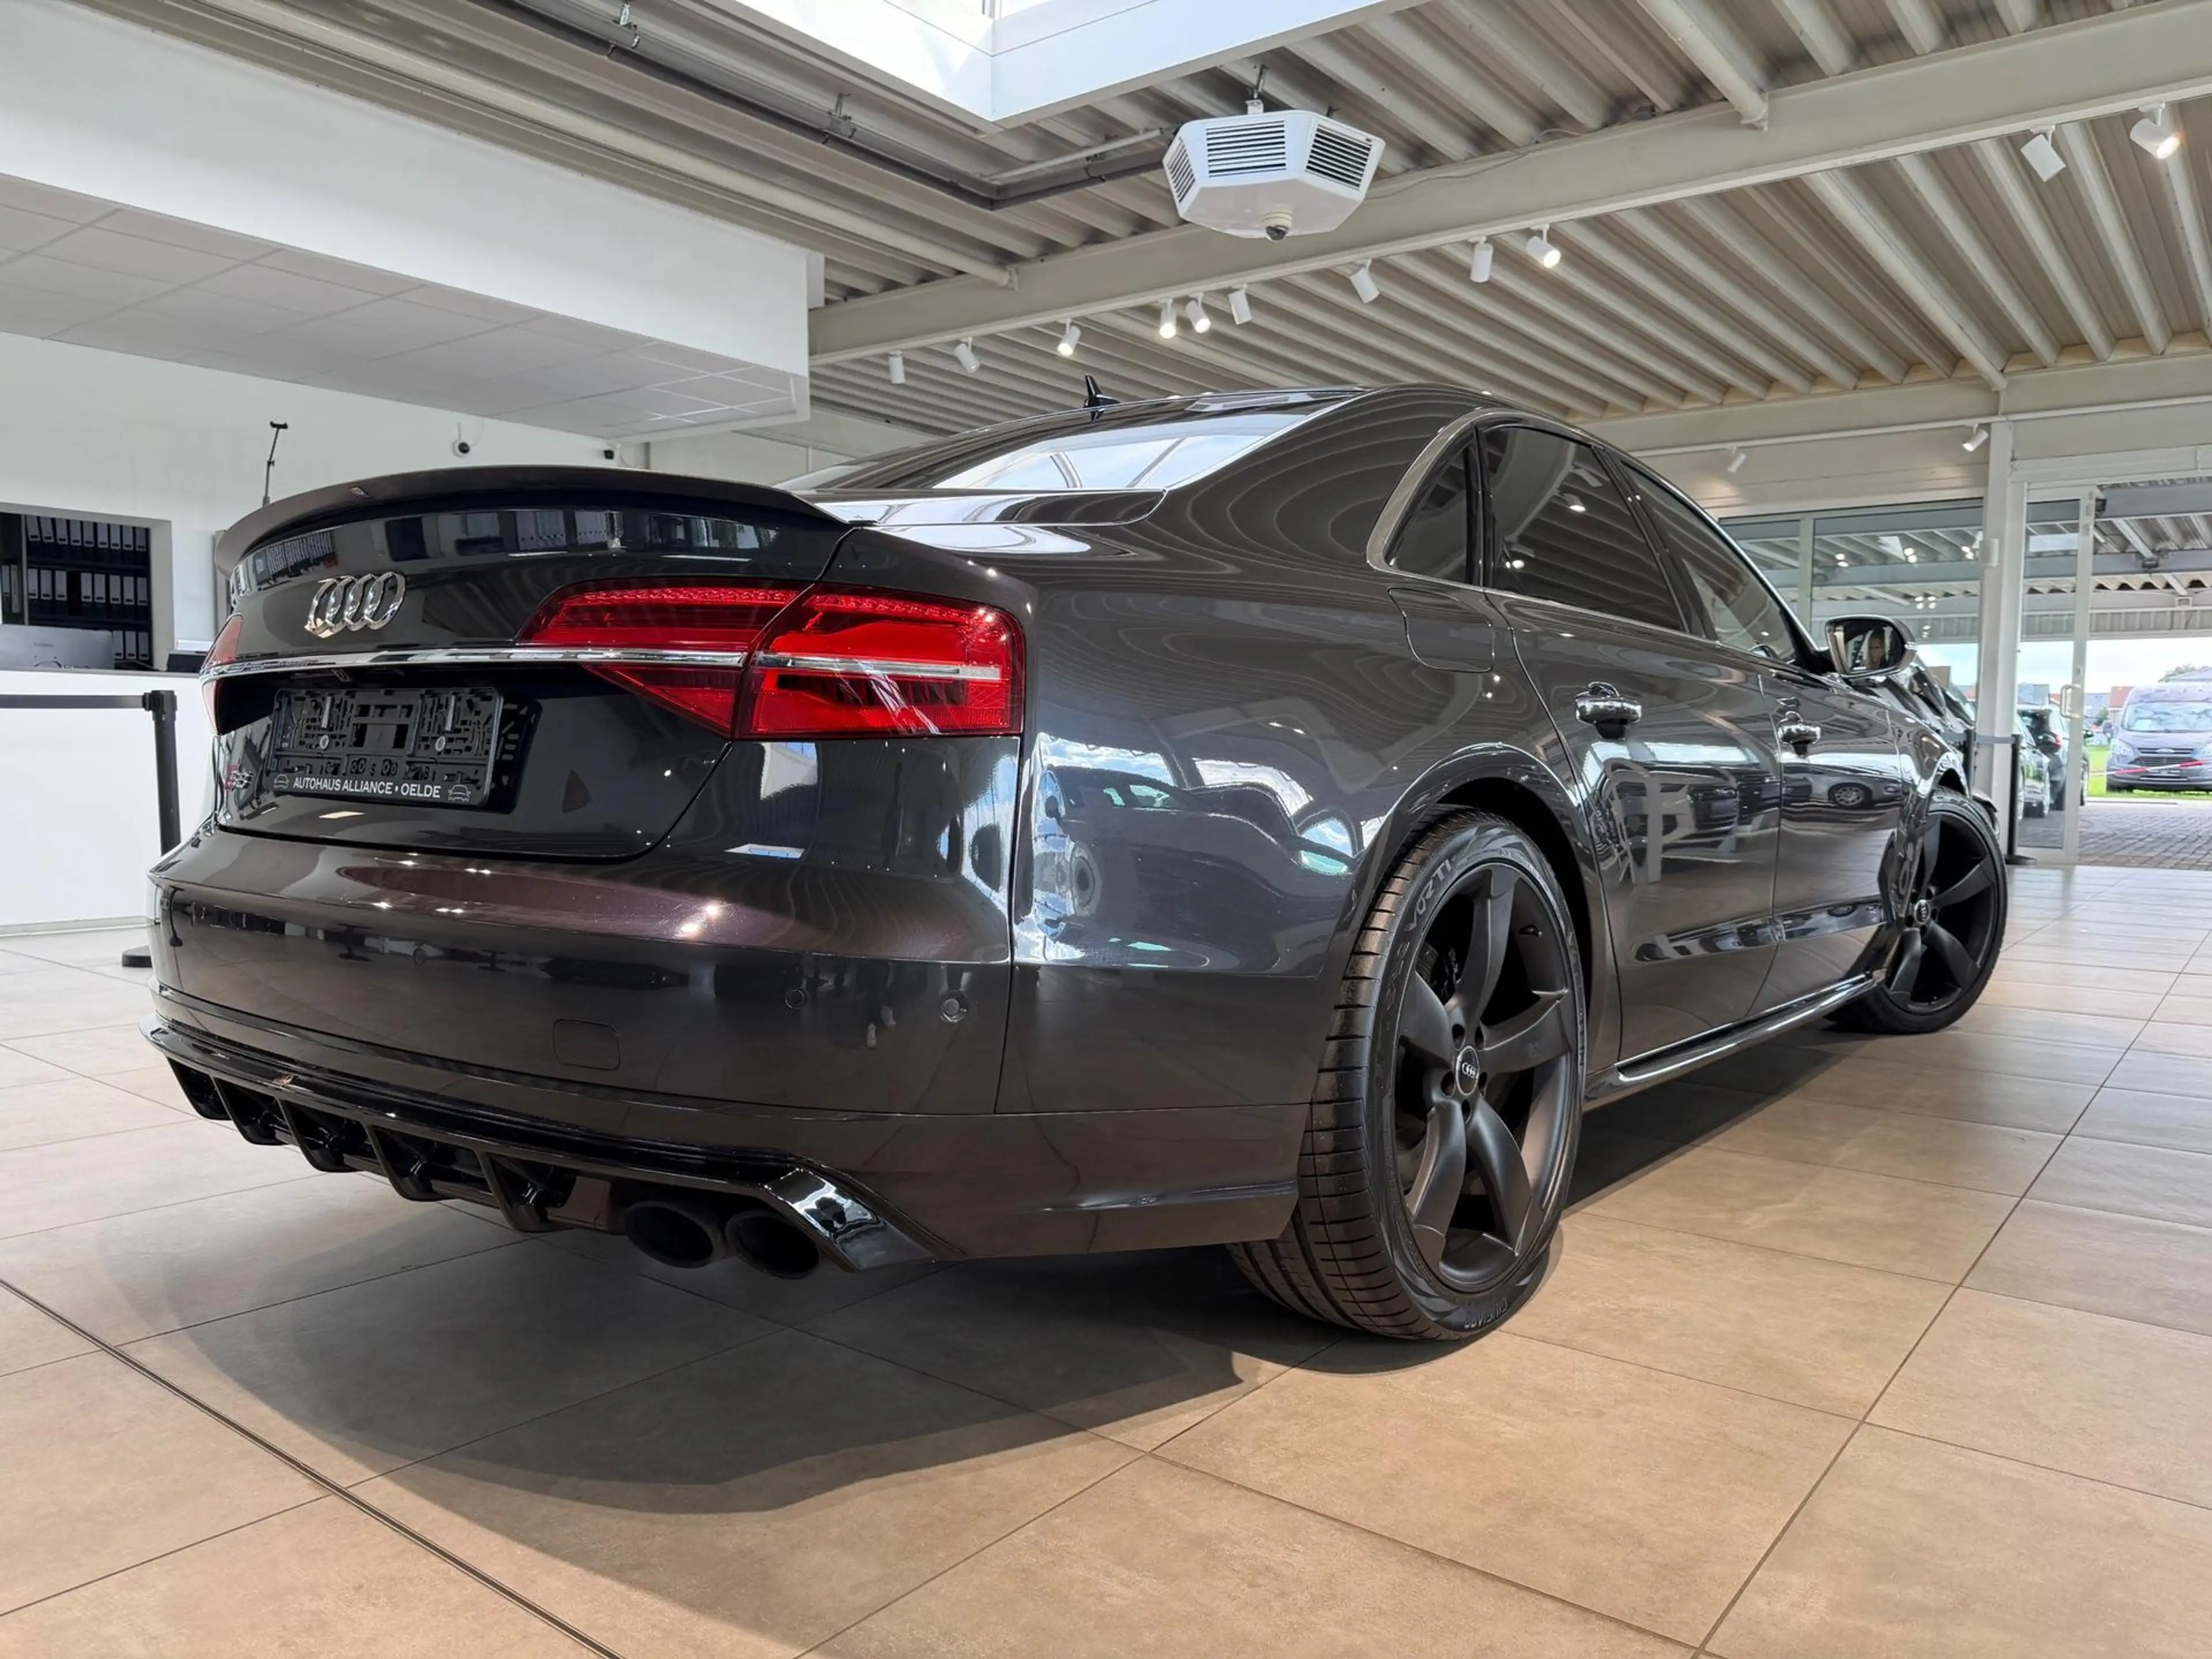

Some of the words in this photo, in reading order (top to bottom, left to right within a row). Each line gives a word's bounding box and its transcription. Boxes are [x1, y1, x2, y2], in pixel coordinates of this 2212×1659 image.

[293, 777, 342, 791] AUTOHAUS
[342, 779, 393, 794] ALLIANCE
[400, 783, 442, 798] OELDE
